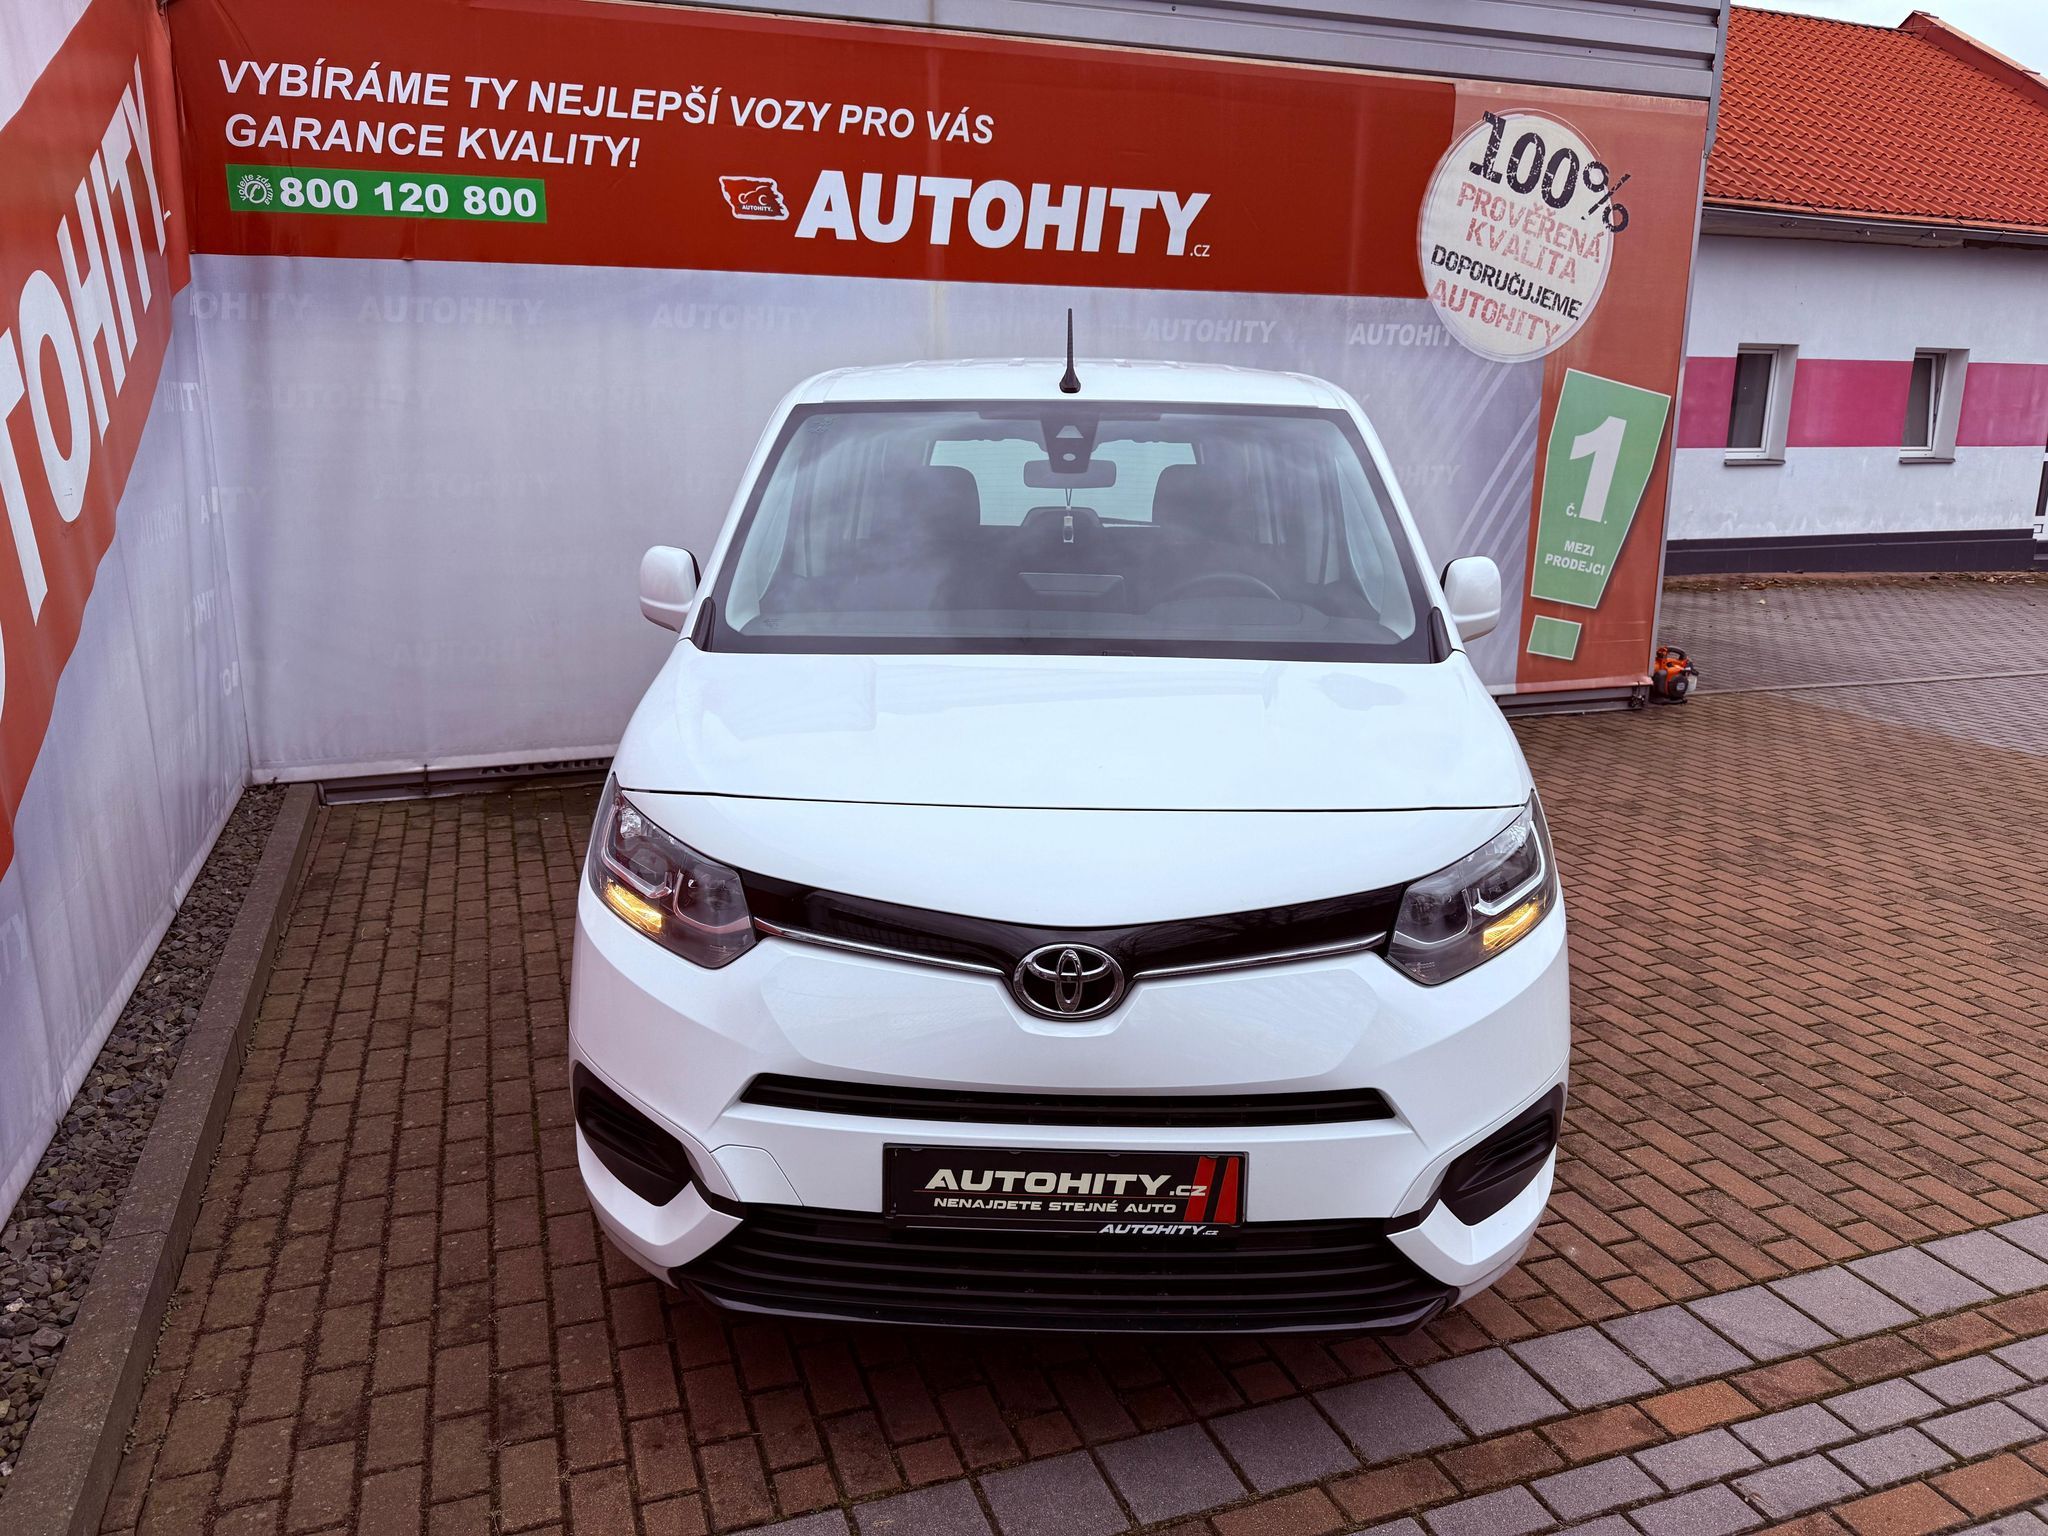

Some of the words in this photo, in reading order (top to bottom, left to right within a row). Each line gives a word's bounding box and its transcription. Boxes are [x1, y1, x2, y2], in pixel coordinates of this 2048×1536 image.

[218, 58, 450, 106] VYBÍRÁME
[463, 76, 519, 110] TY
[527, 81, 722, 124] NEJLEPŠÍ
[730, 95, 832, 132] VOZY
[838, 104, 915, 138] PRO
[926, 106, 994, 144] VÁS
[225, 113, 445, 157] GARANCE
[457, 126, 640, 168] KVALITY!
[237, 174, 254, 201] volejte
[256, 174, 274, 206] zdarma
[1469, 111, 1631, 233] 100%
[280, 177, 358, 209] 800
[374, 181, 448, 213] 120
[463, 185, 537, 217] 800
[1457, 181, 1604, 263] PROVĚŘENÁ
[1466, 217, 1576, 284] KVALITA
[1431, 244, 1583, 320] DOPORUČUJEME
[357, 294, 547, 325] AUTOHITY
[1143, 317, 1278, 344] AUTOHITY
[1427, 278, 1561, 347] AUTOHITY
[1349, 322, 1455, 347] AUTOHIT
[0, 53, 167, 720] TOHITY
[1544, 553, 1605, 576] PRODEJCI
[1564, 540, 1594, 557] MEZI
[934, 1198, 1043, 1211] NENAJDETE
[1048, 1199, 1118, 1213] STEJNÉ
[1124, 1203, 1177, 1213] AUTO
